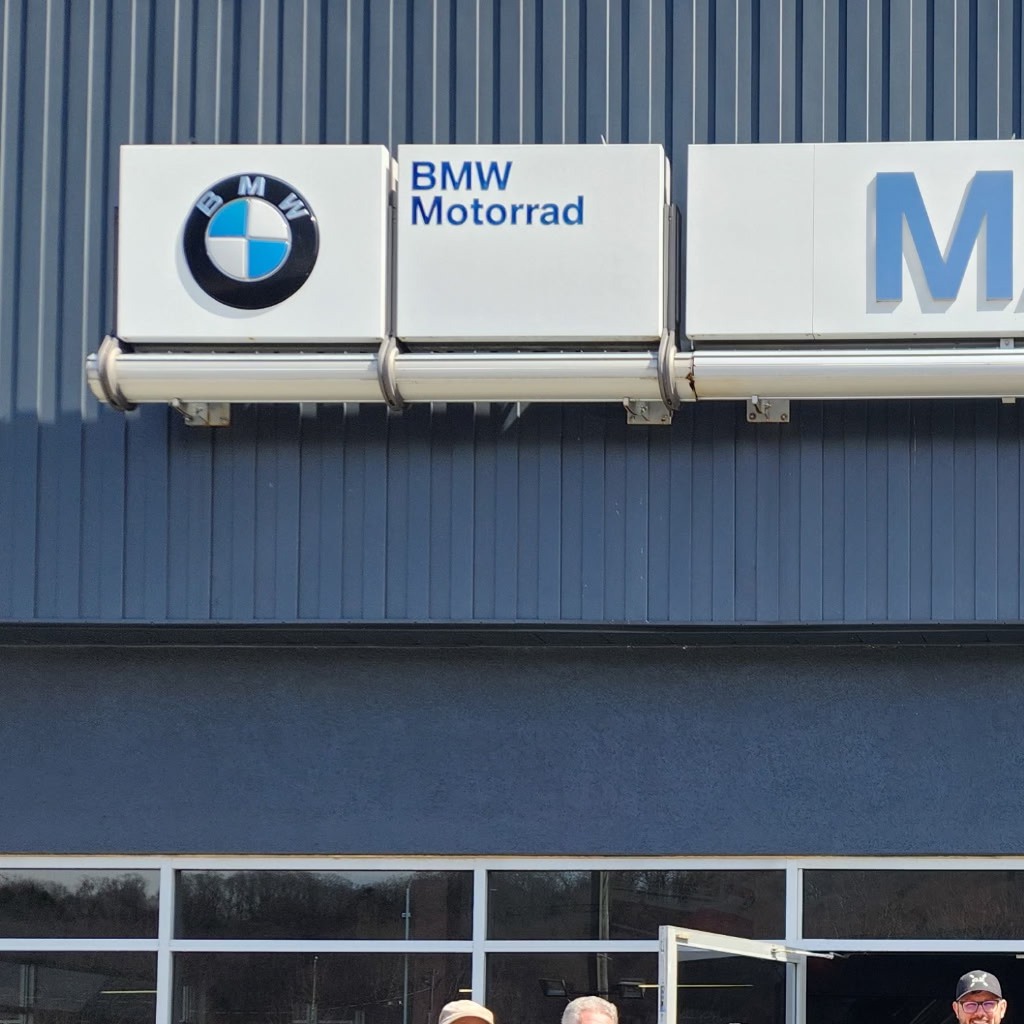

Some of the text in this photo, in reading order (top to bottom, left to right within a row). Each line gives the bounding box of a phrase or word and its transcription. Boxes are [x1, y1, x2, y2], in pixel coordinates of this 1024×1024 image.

[411, 160, 513, 191] BMW
[196, 175, 310, 221] BMW
[411, 195, 584, 226] Motorrad
